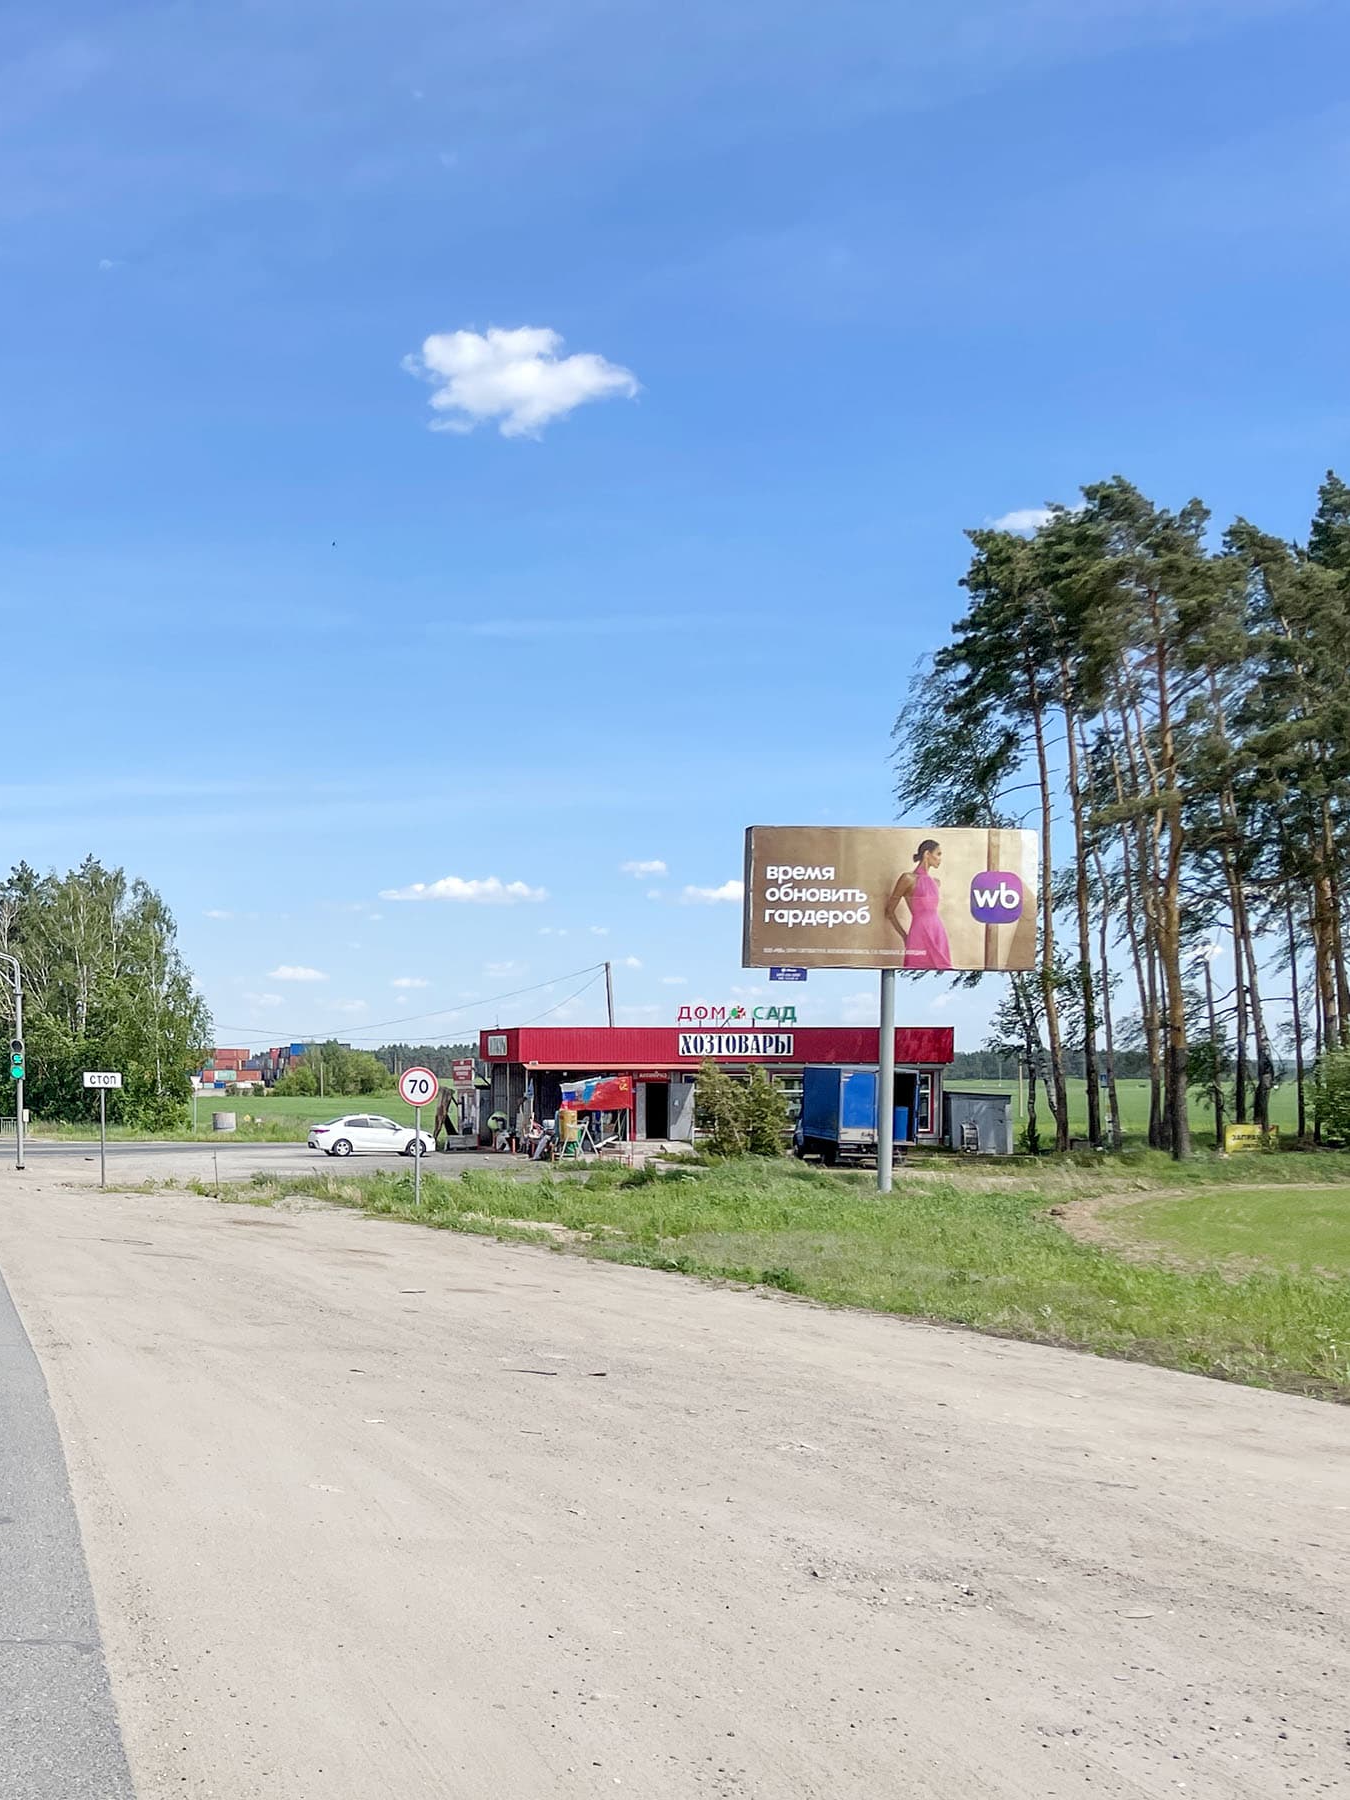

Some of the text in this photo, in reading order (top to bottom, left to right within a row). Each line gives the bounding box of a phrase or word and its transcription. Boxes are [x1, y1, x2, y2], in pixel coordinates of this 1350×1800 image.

[766, 865, 835, 884] время
[765, 883, 868, 902] обновить
[973, 882, 1020, 909] wb
[764, 906, 871, 928] гардероб
[677, 1006, 797, 1022] ДОМ САД
[681, 1034, 792, 1055] ХОЗТОВАРЫ
[90, 1075, 117, 1085] СТОП
[409, 1079, 429, 1094] 70
